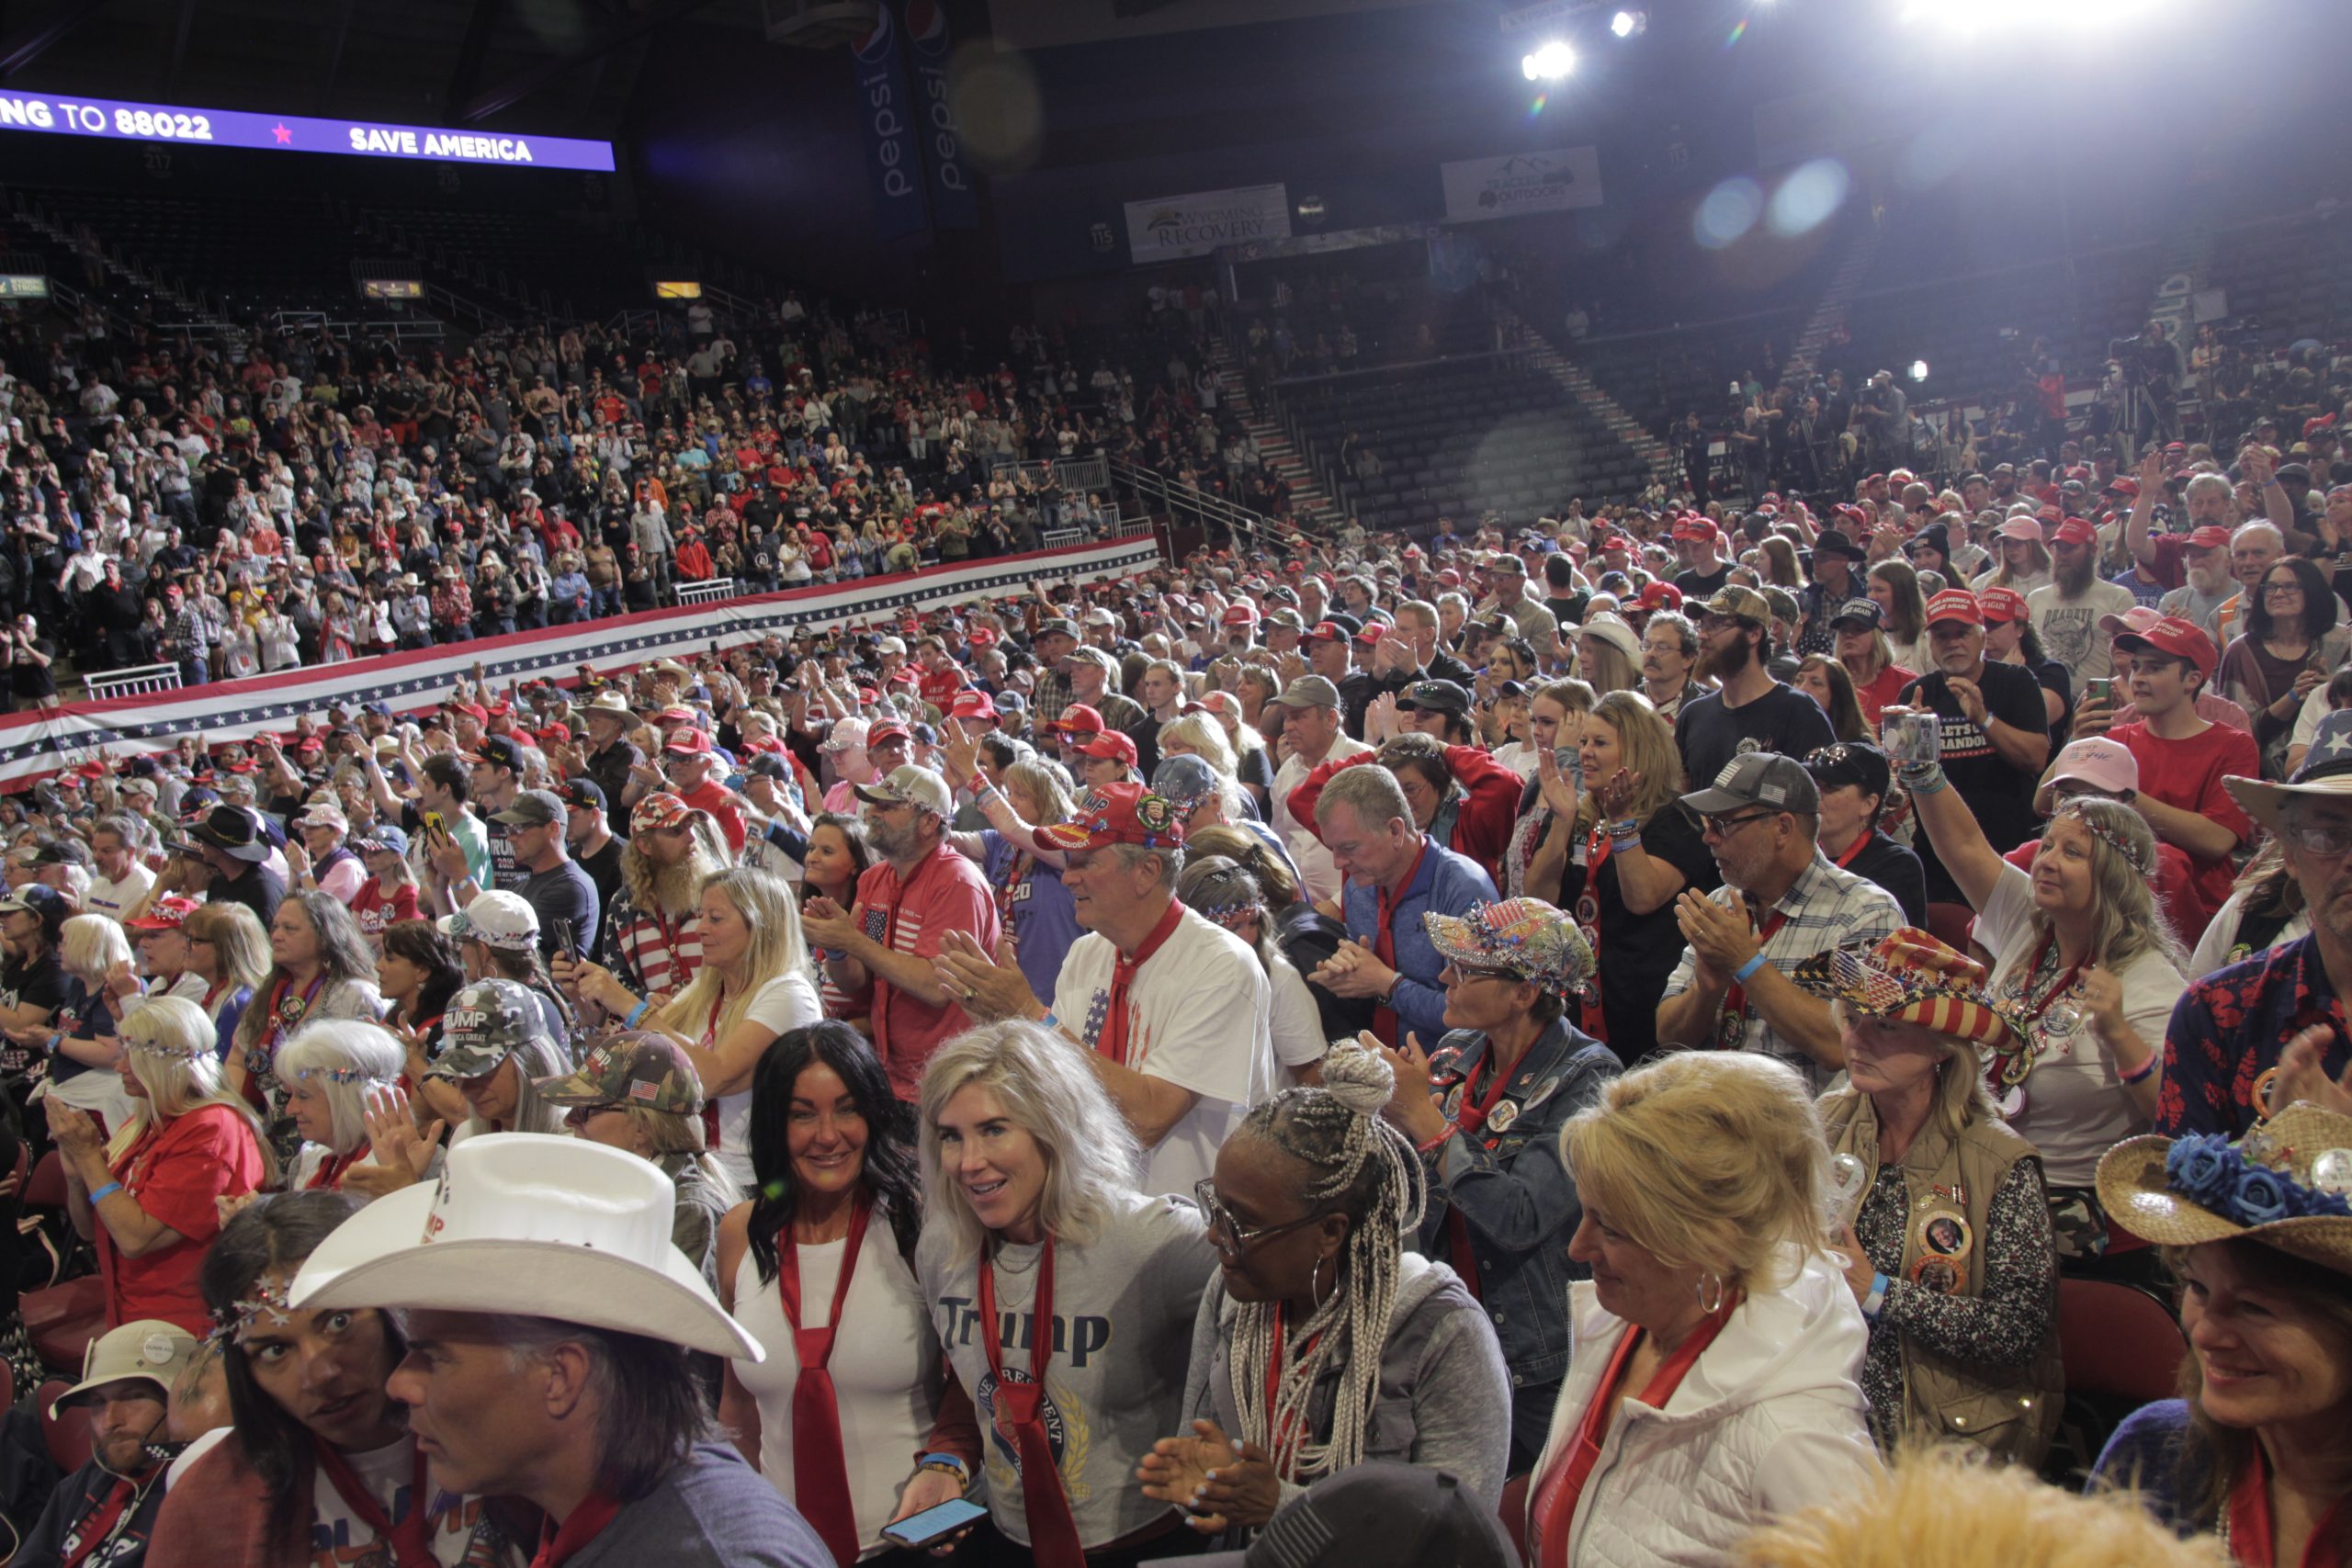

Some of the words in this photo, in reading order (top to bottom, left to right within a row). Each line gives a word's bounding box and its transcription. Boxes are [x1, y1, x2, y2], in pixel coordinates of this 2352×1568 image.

[58, 103, 107, 132] TO
[114, 108, 212, 140] 88022
[920, 66, 967, 191] pepsi
[864, 72, 912, 197] pepsi
[349, 128, 418, 154] SAVE
[424, 133, 533, 162] AMERICA
[1179, 205, 1263, 226] WYOMING
[1091, 231, 1114, 245] 115
[1158, 218, 1265, 247] RECOVERY
[1851, 599, 1877, 612] AMERICA
[1941, 597, 1971, 605] AMERICA
[1853, 606, 1872, 617] AGAIN
[1939, 724, 1970, 736] LETS
[1939, 735, 1986, 750] RANDO
[490, 839, 515, 856] TRUM
[1053, 836, 1091, 849] PRESIDENT
[465, 1032, 487, 1043] GREAT
[1915, 1257, 1940, 1269] TRUMP
[938, 1295, 1111, 1368] Trump
